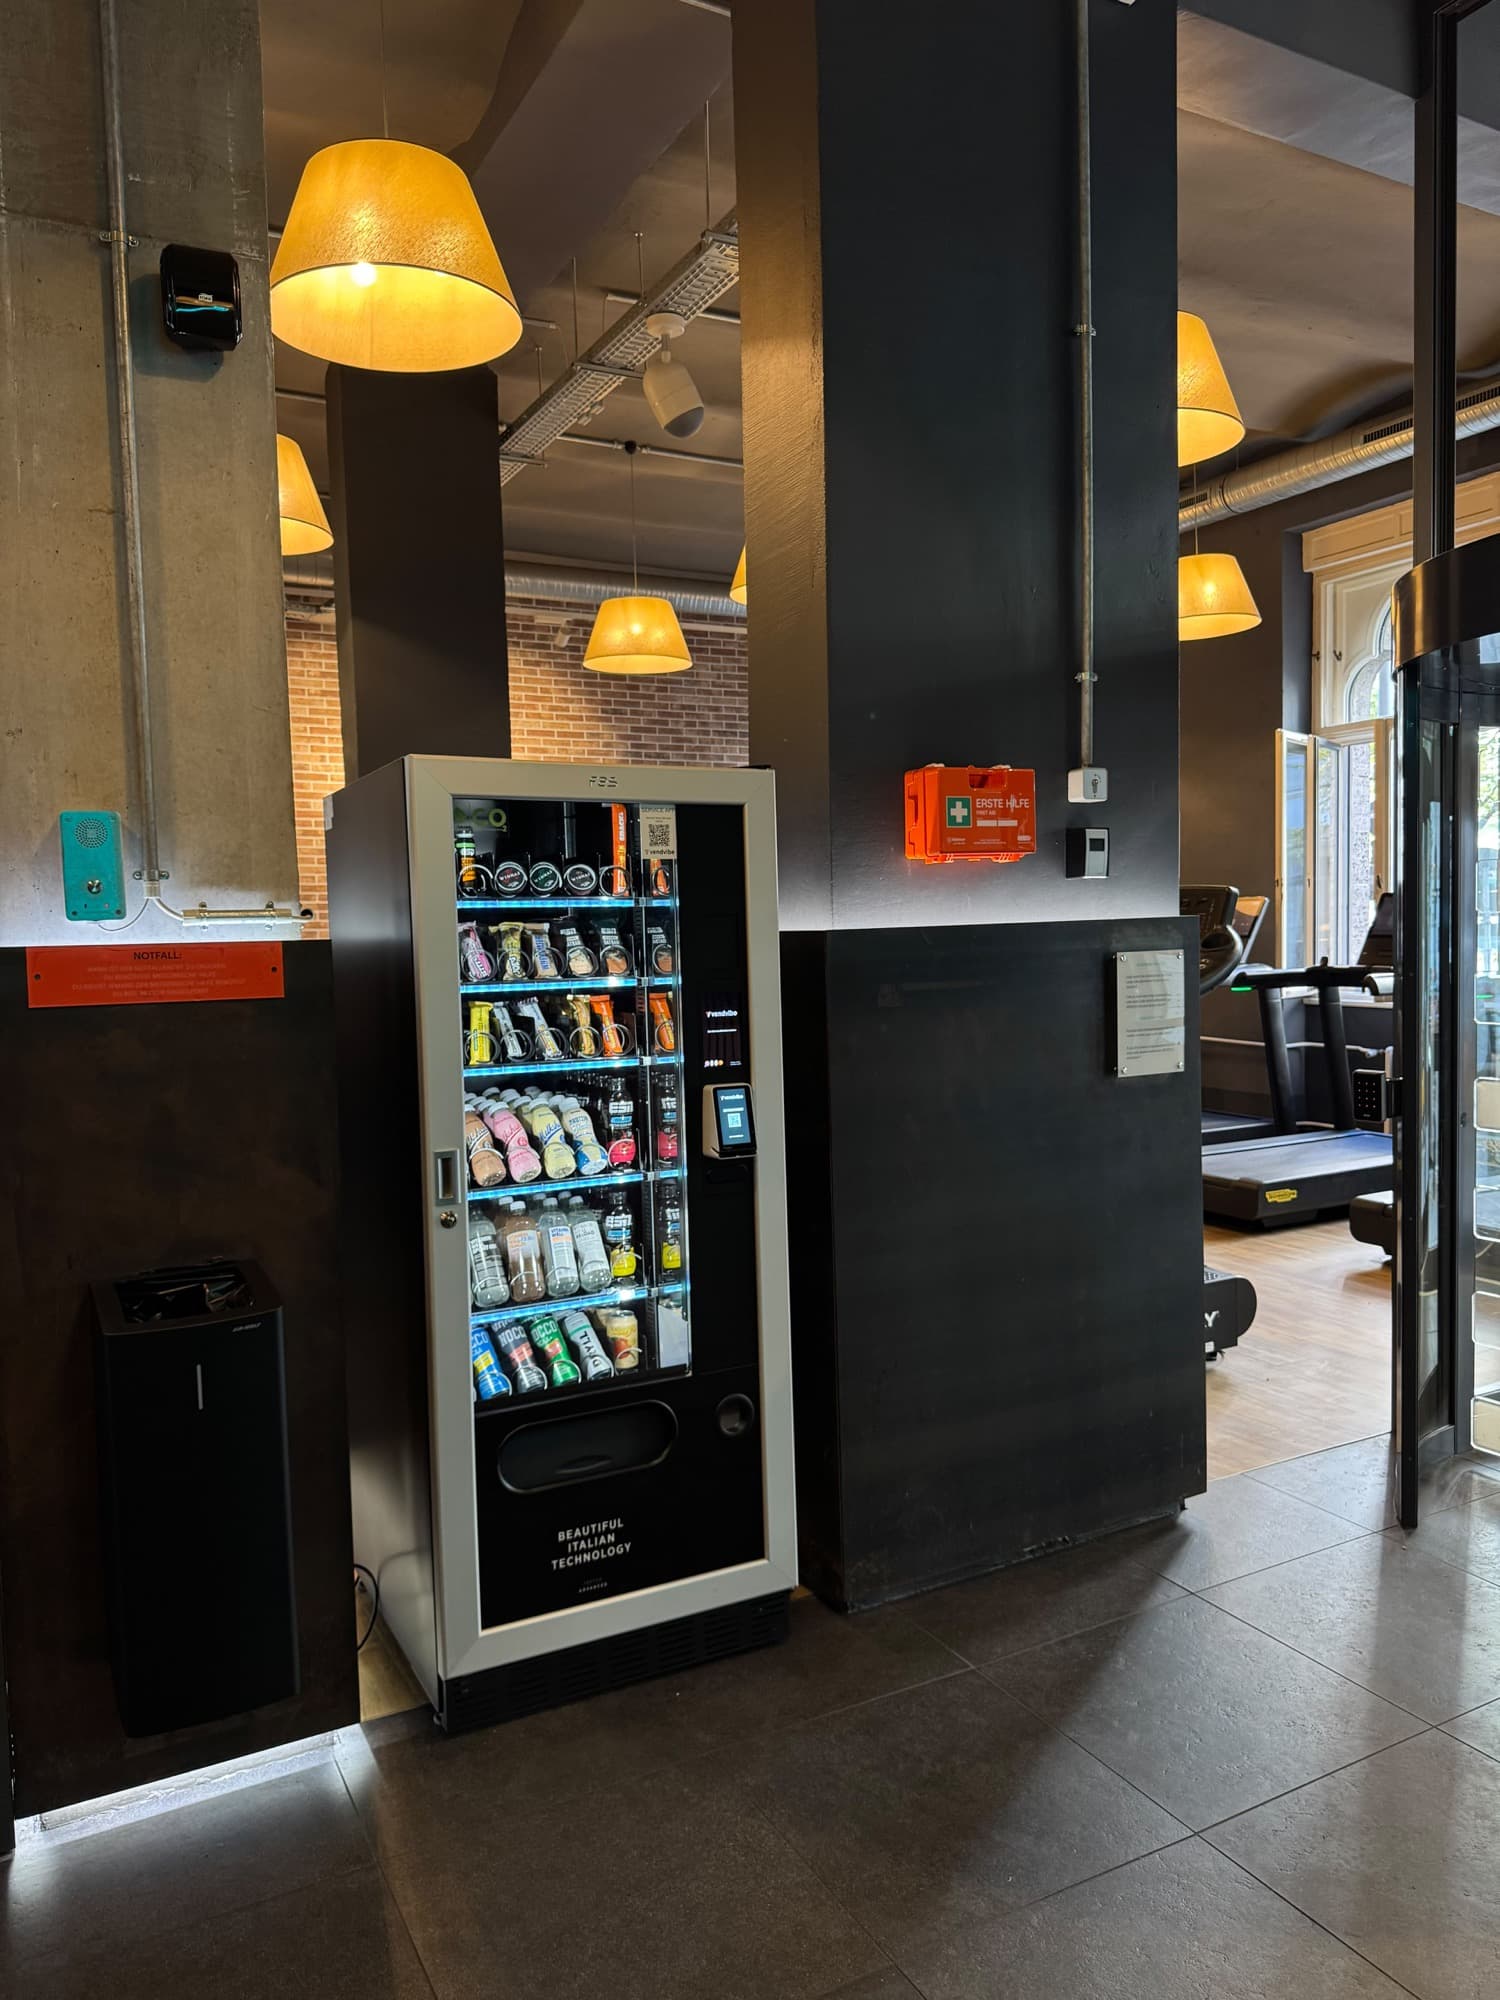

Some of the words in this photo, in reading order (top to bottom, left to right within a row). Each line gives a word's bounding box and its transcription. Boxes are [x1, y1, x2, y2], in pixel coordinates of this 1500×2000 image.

[976, 798, 1004, 809] ERSTE
[1006, 798, 1030, 809] HILFE
[133, 951, 182, 961] NOTFALL:
[558, 1517, 624, 1542] BEAUTIFUL
[567, 1532, 615, 1553] ITALIAN
[551, 1541, 632, 1571] TECHNOLOGY
